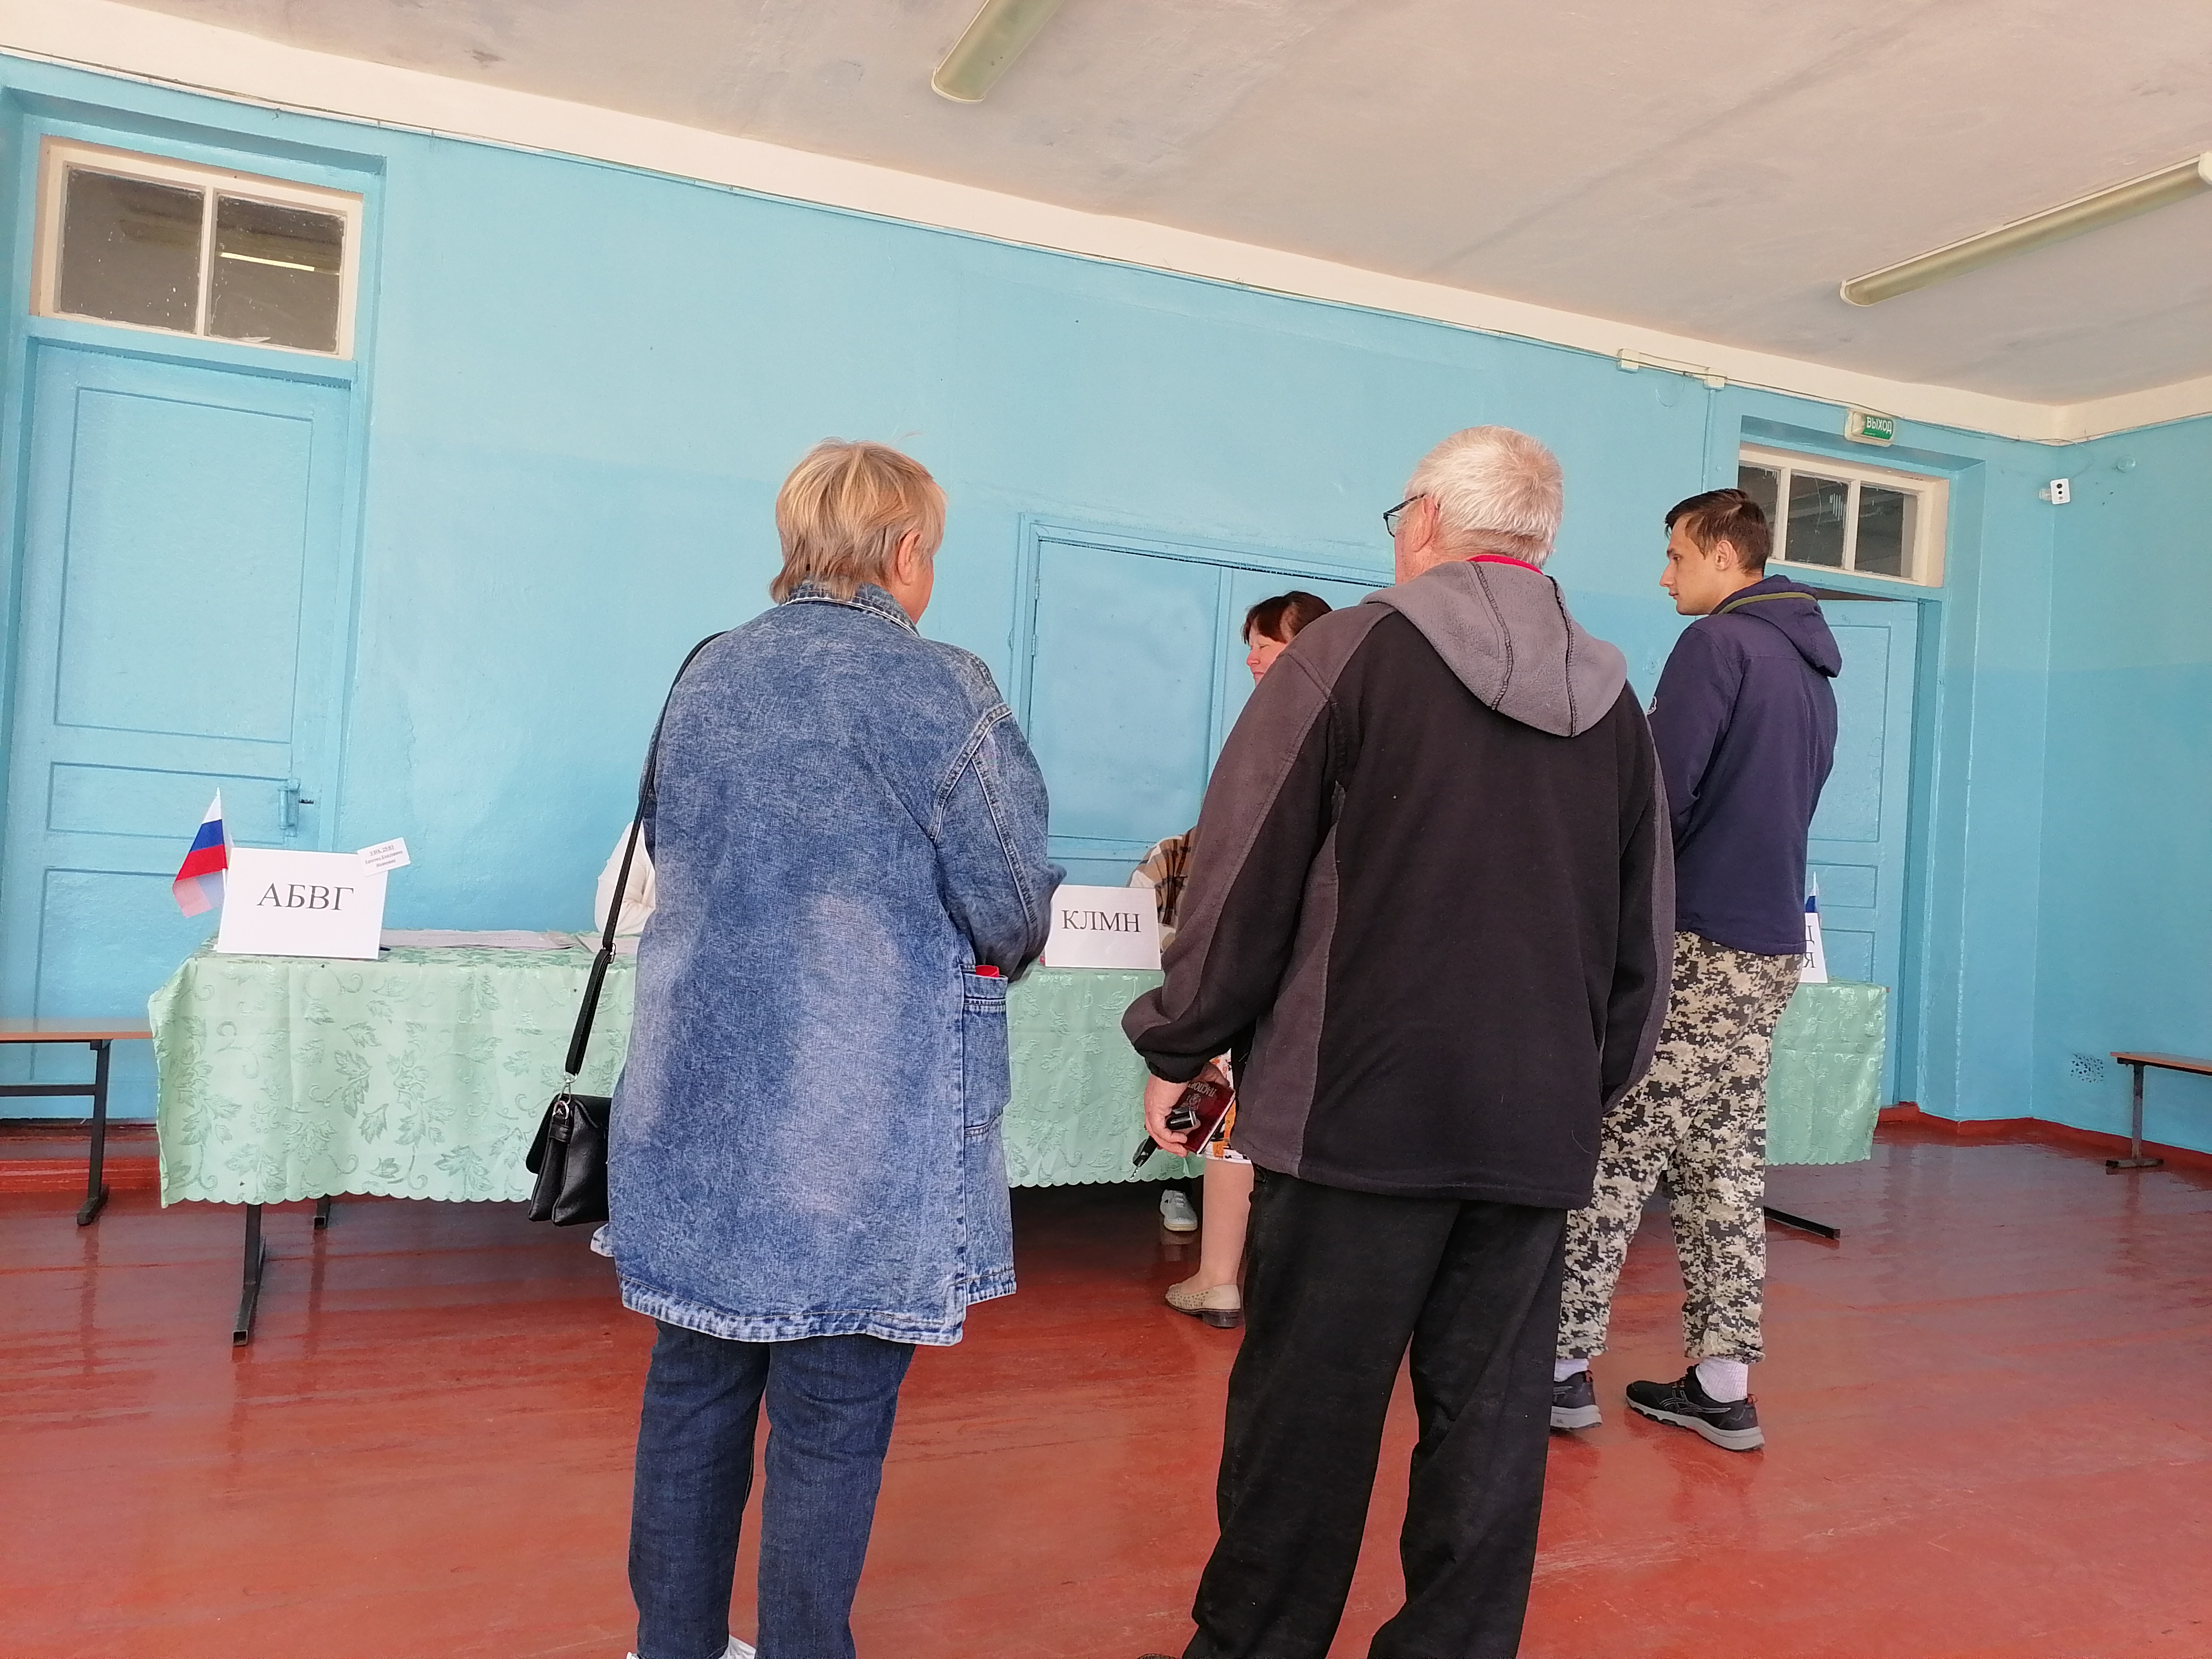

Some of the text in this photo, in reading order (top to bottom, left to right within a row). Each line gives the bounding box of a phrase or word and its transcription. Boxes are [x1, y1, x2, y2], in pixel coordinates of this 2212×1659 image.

[1866, 416, 1892, 435] ВЫХОД
[256, 883, 354, 910] АБВГ
[1061, 910, 1141, 932] КЛМН
